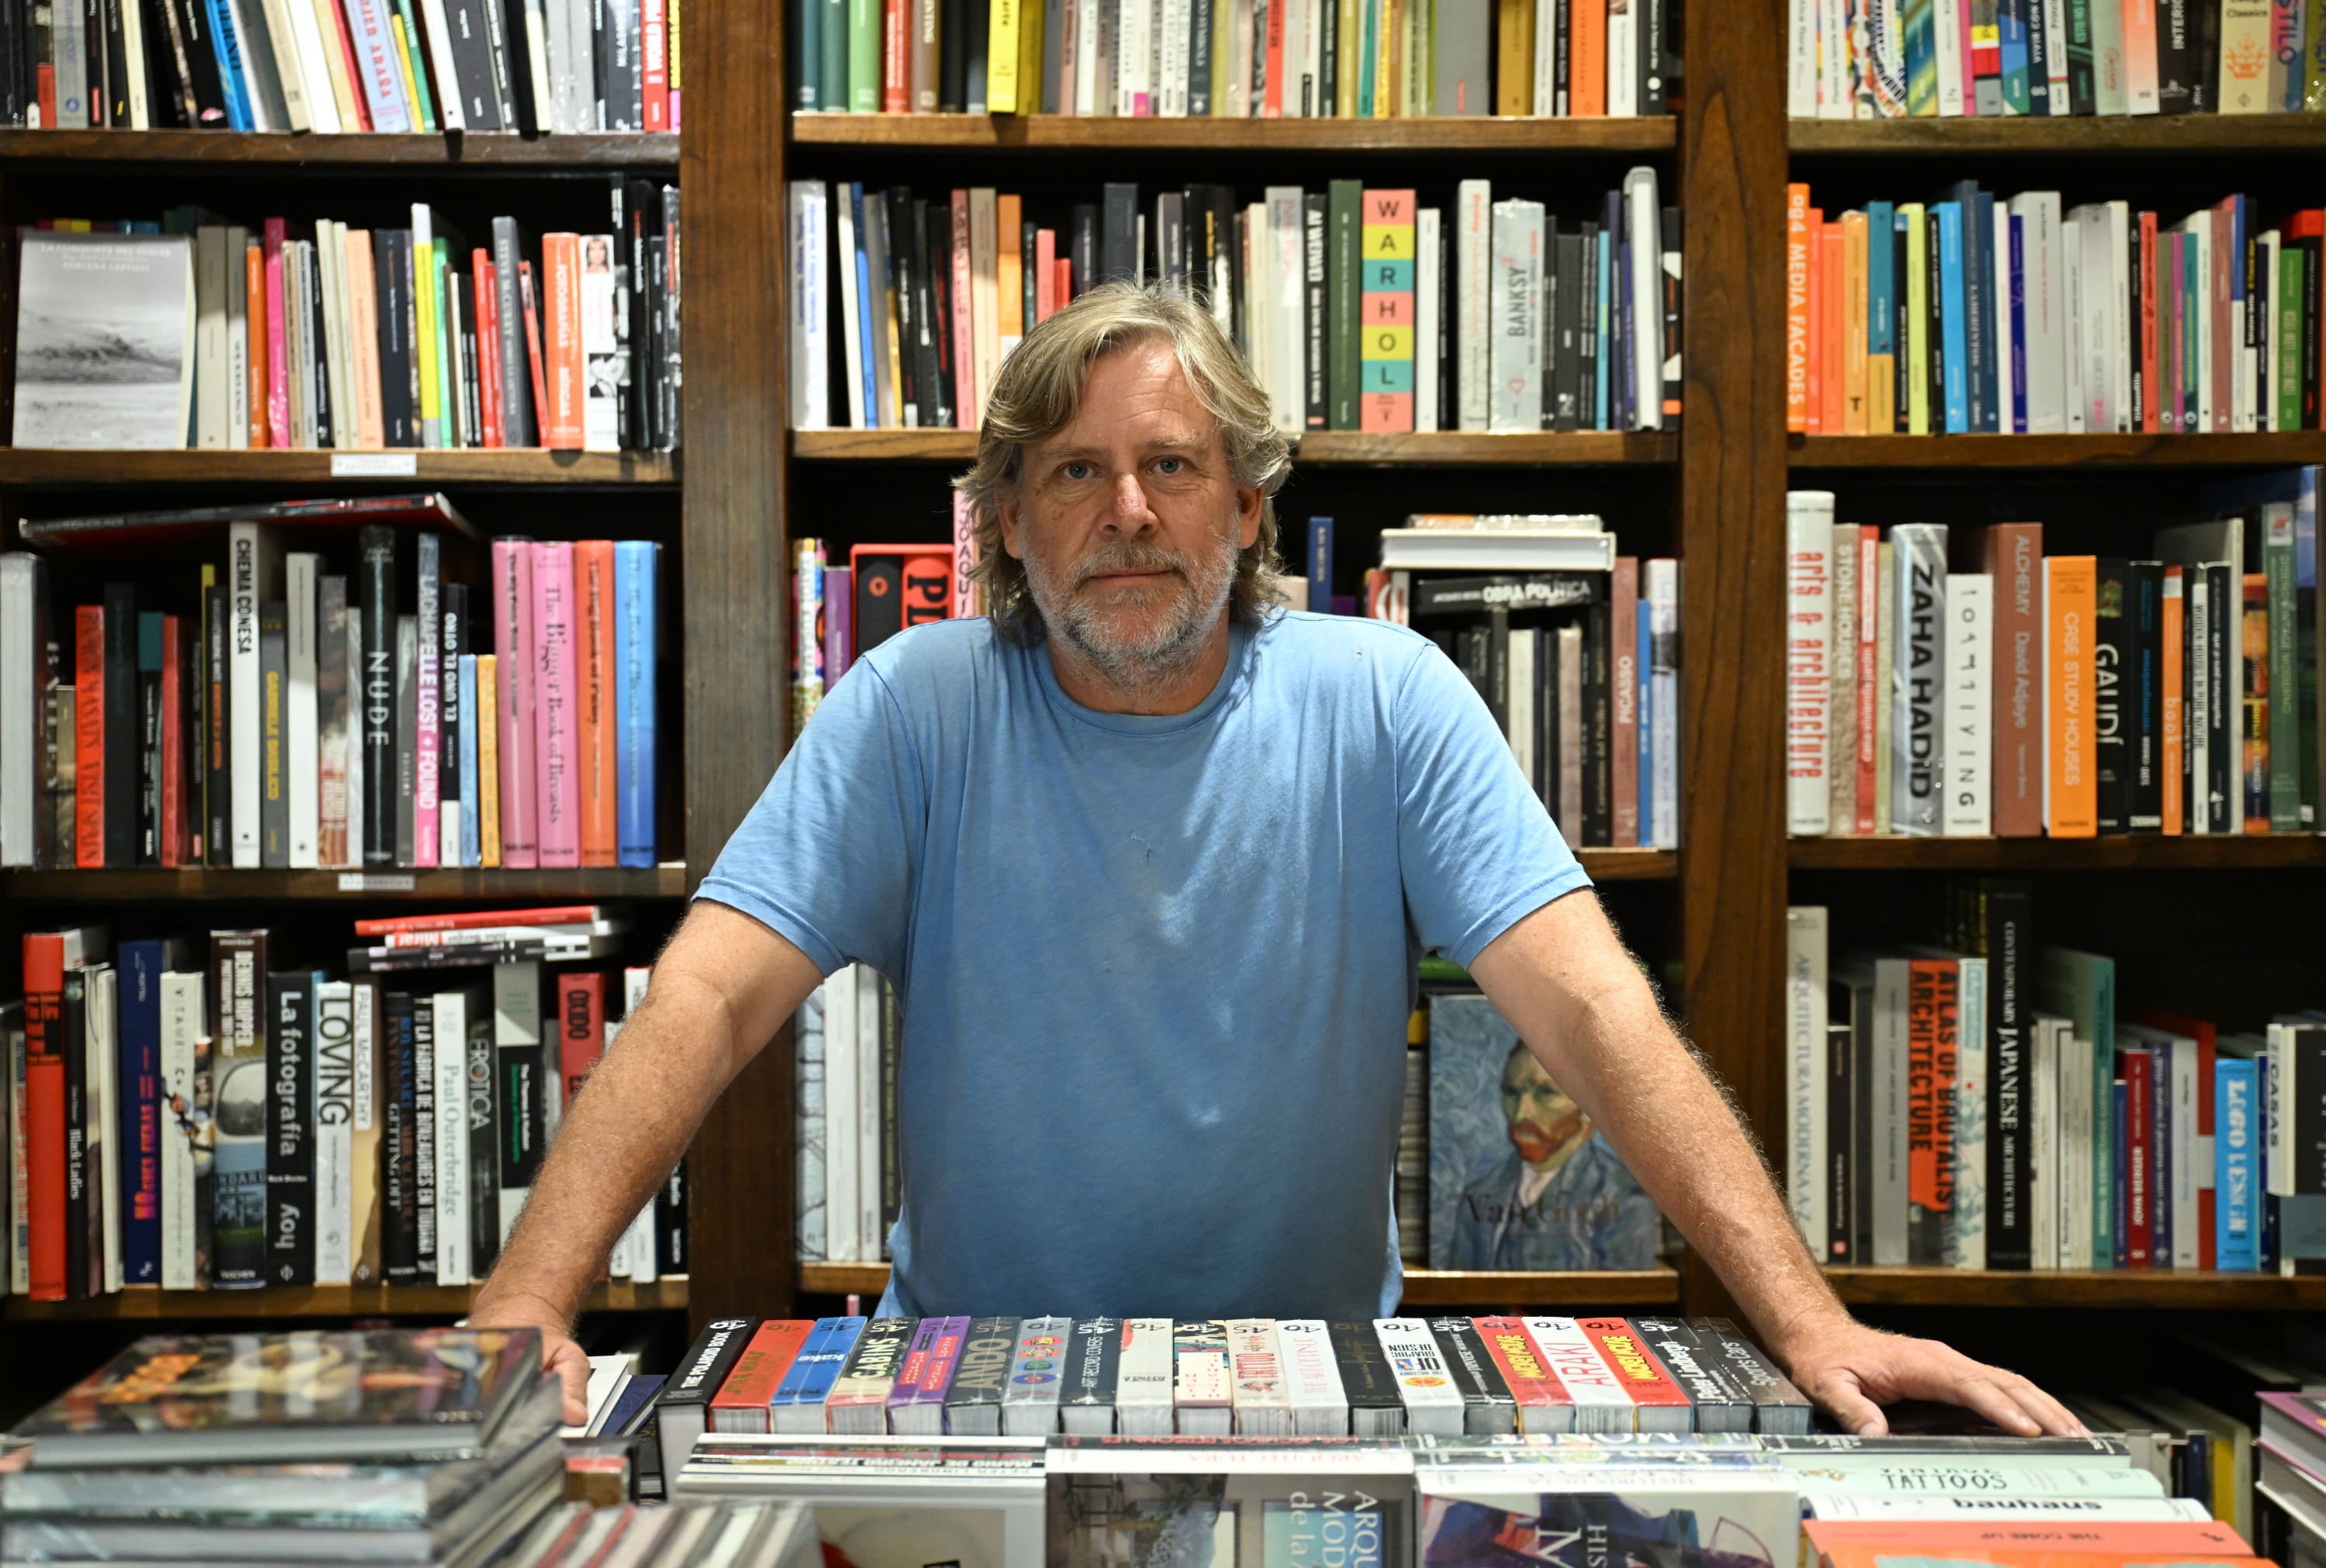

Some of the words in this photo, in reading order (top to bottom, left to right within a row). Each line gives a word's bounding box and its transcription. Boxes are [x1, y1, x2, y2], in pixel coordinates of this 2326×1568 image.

[2226, 9, 2269, 20] Classics
[371, 43, 392, 99] ARAÑA
[1789, 194, 1806, 233] ag4
[1307, 226, 1324, 282] WEIWEI
[1377, 201, 1400, 385] WARHOL
[1790, 243, 1806, 307] MEDIA
[556, 264, 570, 348] FOTOGRAFÍAS
[1506, 267, 1526, 337] BANKSY
[1790, 315, 1806, 405] FACADES
[236, 539, 252, 593] CHEMA
[1789, 551, 1828, 596] arts
[1837, 544, 1854, 605] STONE
[2016, 535, 2031, 615] ALCHEMY
[544, 584, 561, 619] The
[1482, 585, 1525, 603] OBRA
[236, 596, 252, 654] CONESA
[419, 574, 437, 686] LACHAPELLE
[443, 614, 457, 641] OTRO
[1910, 563, 1934, 670] ZAHA
[2062, 612, 2079, 656] CASE
[443, 653, 457, 670] EL
[541, 622, 566, 692] Bigger
[1837, 606, 1854, 680] HOUSES
[2016, 632, 2031, 675] David
[267, 672, 280, 736] GABRIELE
[367, 651, 389, 746] NUDE
[443, 673, 457, 703] UNO
[1618, 656, 1633, 724] PICASSO
[2013, 676, 2031, 728] Adjaye
[2062, 660, 2079, 714] STUDY
[2095, 643, 2124, 746] GAUDÍ
[419, 688, 437, 732] LOST
[443, 706, 457, 722] EL
[547, 697, 564, 739] Book
[1789, 639, 1830, 778] architecture
[2164, 696, 2180, 746] book
[547, 743, 564, 761] of
[1910, 677, 1934, 799] HADID
[2062, 719, 2079, 787] HOUSES
[419, 750, 437, 809] FOUND
[547, 763, 565, 823] Breasts
[393, 932, 443, 948] Mirar
[235, 950, 254, 997] DENNIS
[2003, 921, 2016, 1025] CONTEMPORARY
[235, 998, 254, 1047] HOPPER
[280, 991, 303, 1023] La
[356, 991, 371, 1029] PAUL
[1795, 956, 1813, 1093] ARQUITECTURA
[1936, 970, 1956, 1053] ATLAS
[318, 997, 352, 1127] LOVING
[356, 1037, 371, 1126] McCARTHY
[1910, 970, 1934, 1152] ARCHITECTURE
[1936, 1054, 1955, 1081] OF
[1996, 1026, 2019, 1130] JAPANESE
[275, 1028, 303, 1157] fotografía
[441, 1064, 459, 1104] Paul
[468, 1038, 492, 1131] EROTICA
[2228, 1079, 2248, 1149] LOGO
[2269, 1063, 2279, 1149] CASAS
[68, 1129, 83, 1161] Black
[388, 1102, 402, 1177] GETTING
[1795, 1094, 1812, 1192] MODERNA
[69, 1161, 83, 1200] Ladies
[438, 1106, 459, 1216] Outerbridge
[2132, 1146, 2145, 1194] BERGER
[388, 1178, 402, 1212] OFF
[2132, 1196, 2145, 1227] JOHN
[274, 1203, 301, 1249] hoy
[708, 1331, 731, 1349] BOOK
[819, 1322, 858, 1332] 45
[869, 1322, 909, 1332] 45
[1078, 1325, 1115, 1335] 45
[1129, 1322, 1166, 1332] 40
[1233, 1325, 1270, 1335] 45
[1283, 1325, 1322, 1334] 40
[1383, 1324, 1421, 1333] 40
[1434, 1323, 1472, 1332] 45
[1494, 1333, 1529, 1359] MOUSE
[1534, 1322, 1573, 1332] 40
[1586, 1322, 1625, 1331] 40
[1640, 1322, 1679, 1332] 45
[687, 1346, 722, 1377] POLAROID
[797, 1353, 846, 1363] kake
[852, 1336, 902, 1380] CABINS
[956, 1338, 1009, 1391] ANDO
[1387, 1343, 1434, 1352] DESIGN
[1389, 1350, 1437, 1359] GRAPHIC
[1414, 1357, 1442, 1372] OF
[1506, 1353, 1548, 1380] MICKEY
[1542, 1341, 1617, 1389] ARAKI
[1601, 1335, 1643, 1362] MOUSE
[1617, 1355, 1661, 1381] MICKEY
[1654, 1339, 1707, 1380] Lindbergh
[1720, 1340, 1753, 1362] Cars
[679, 1373, 699, 1390] THE
[1690, 1375, 1727, 1404] Peter
[1741, 1356, 1781, 1388] Sports
[862, 1459, 944, 1468] JANEIRO
[971, 1459, 1034, 1468] MARIO
[1883, 1473, 2008, 1490] TATTOOS
[1289, 1490, 1317, 1526] de
[1952, 1497, 2104, 1511] bauhaus
[1289, 1533, 1317, 1556] la
[1980, 1532, 2004, 1541] UP
[2007, 1532, 2064, 1541] COME
[2067, 1532, 2104, 1541] THE
